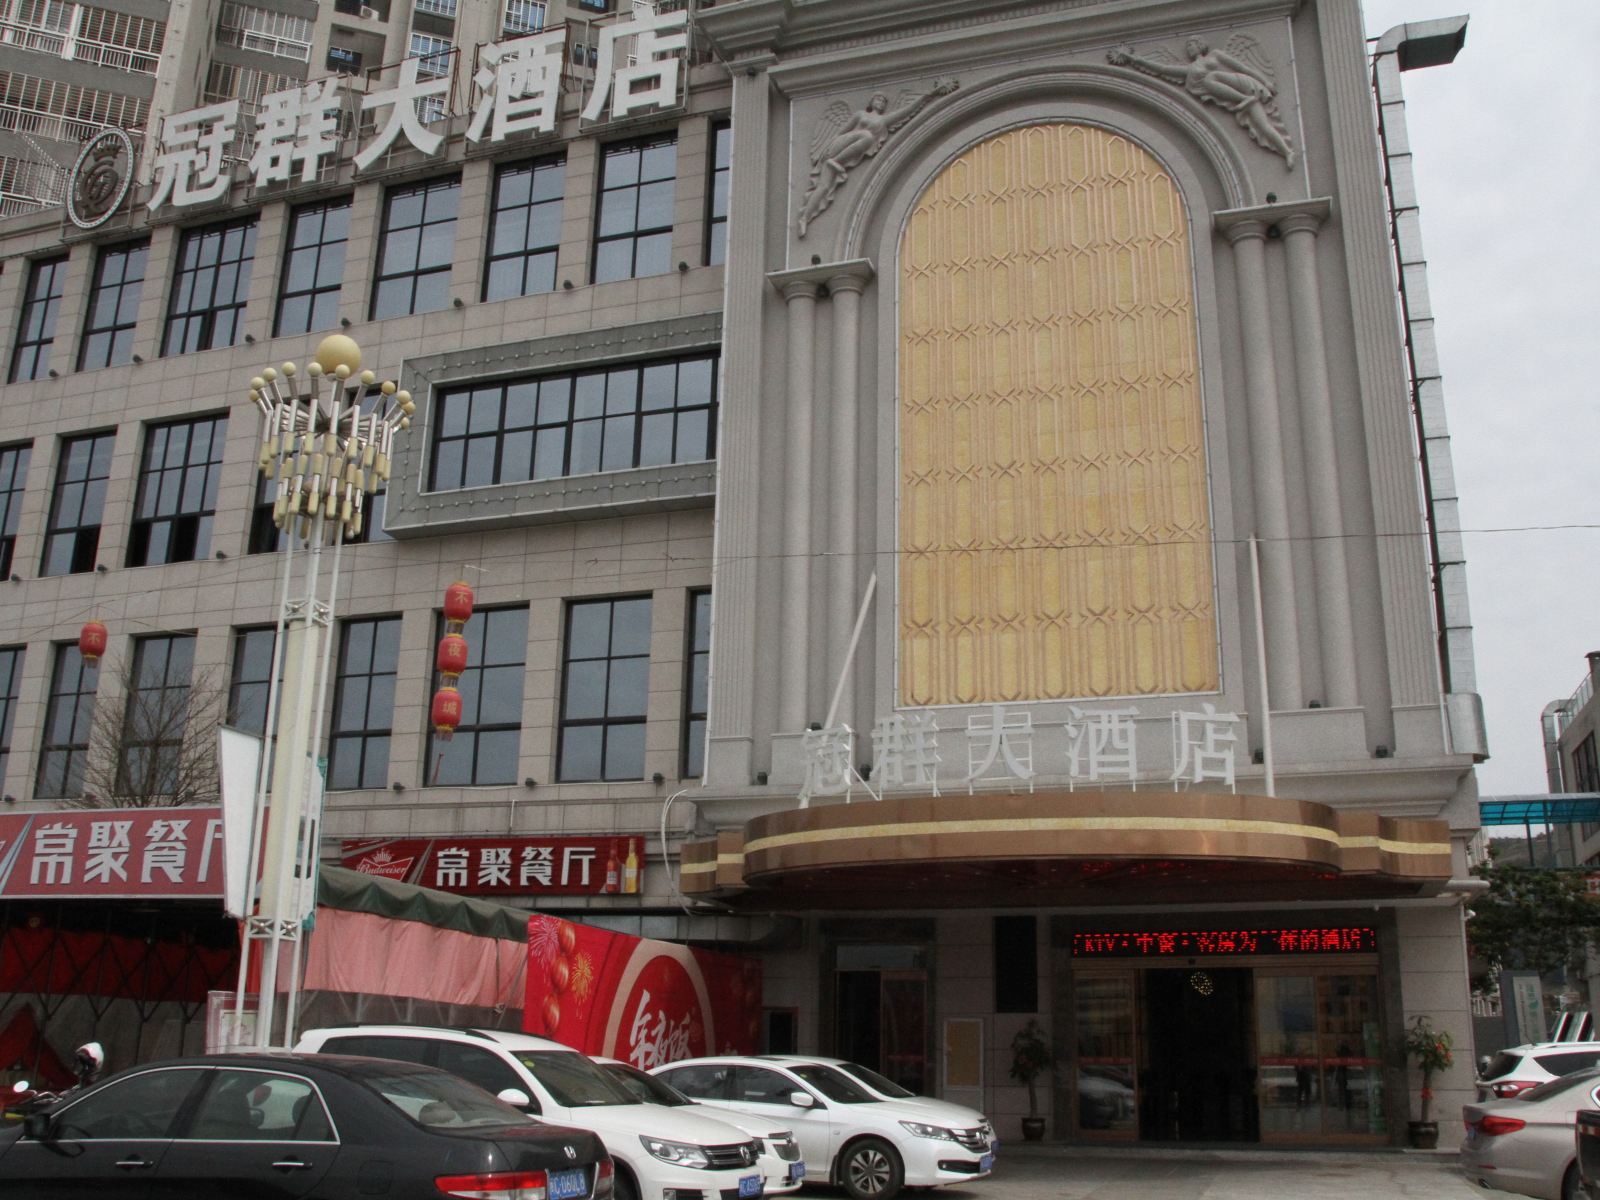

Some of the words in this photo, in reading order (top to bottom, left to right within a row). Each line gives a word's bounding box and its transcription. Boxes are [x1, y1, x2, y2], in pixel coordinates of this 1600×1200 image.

[146, 4, 690, 212] 冠群大酒店
[798, 703, 1240, 799] 冠群大酒店
[436, 846, 596, 887] 常聚餐厅
